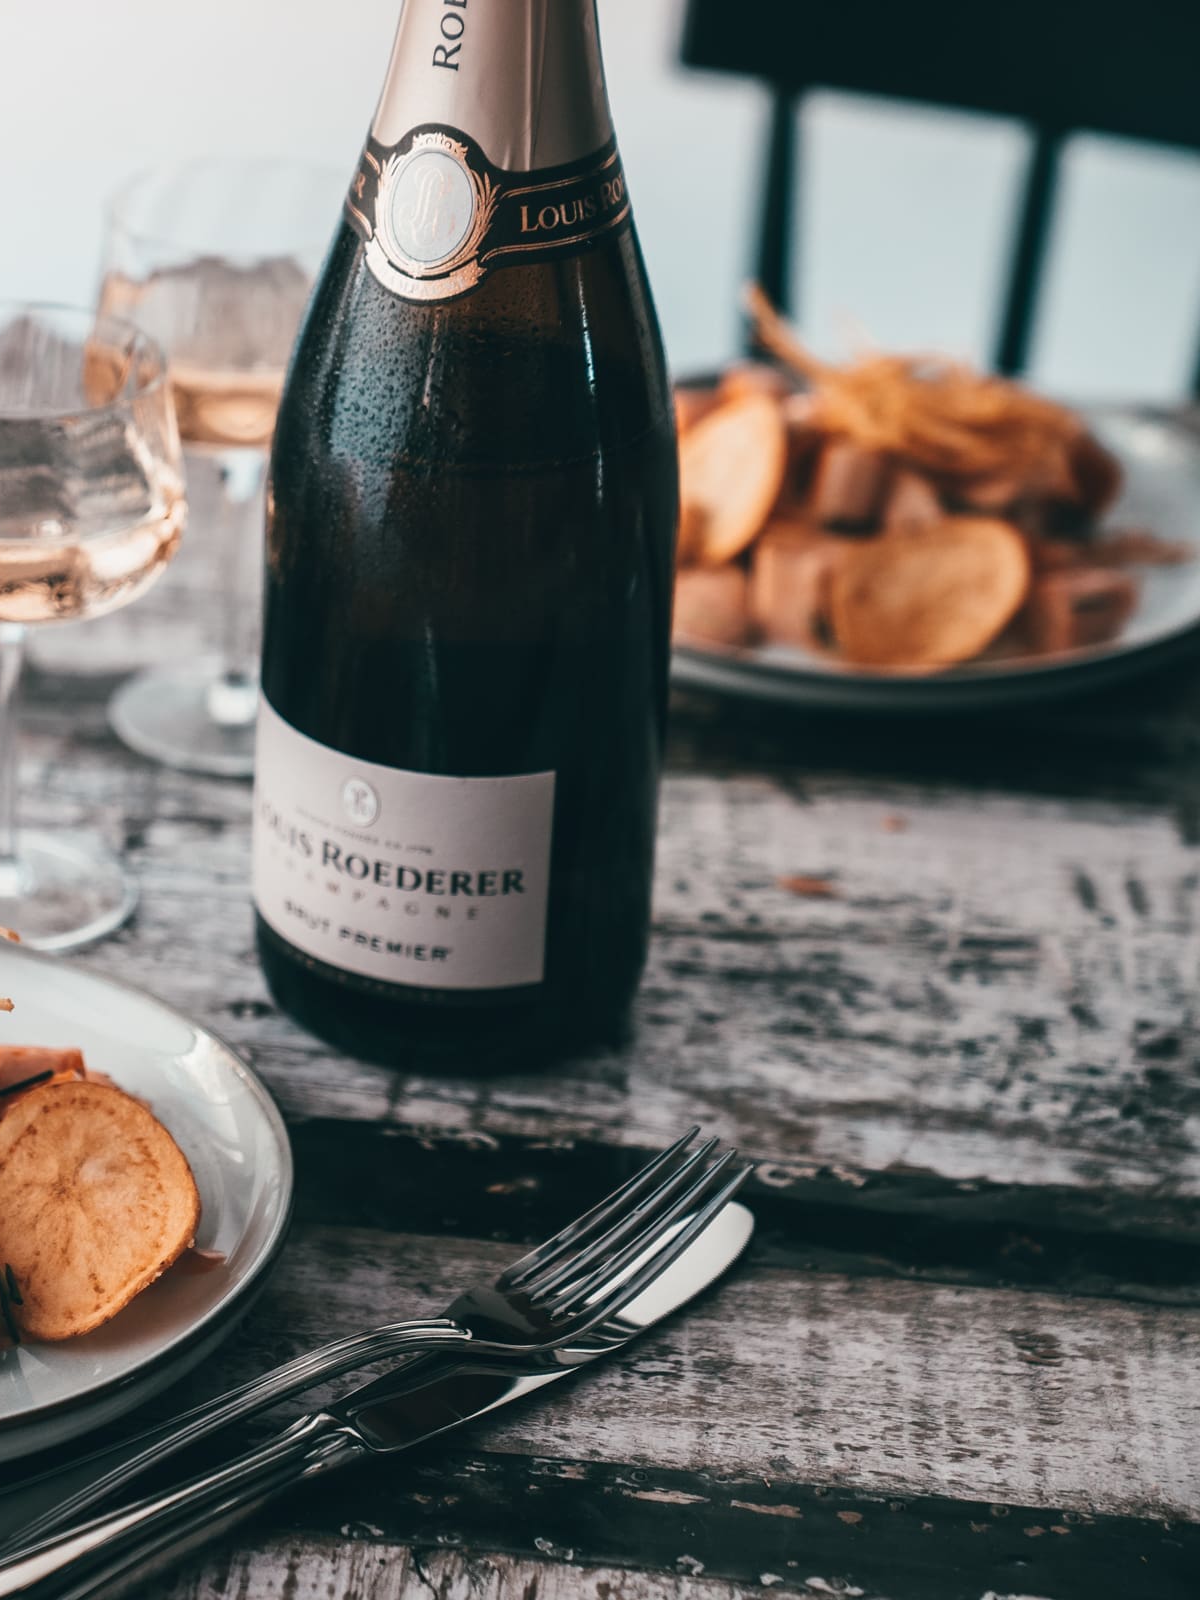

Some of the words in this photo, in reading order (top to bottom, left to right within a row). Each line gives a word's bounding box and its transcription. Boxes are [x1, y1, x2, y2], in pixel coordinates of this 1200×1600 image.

[519, 194, 598, 233] LOUIS
[321, 839, 527, 897] ROEDERER
[338, 925, 450, 962] PREMIER
